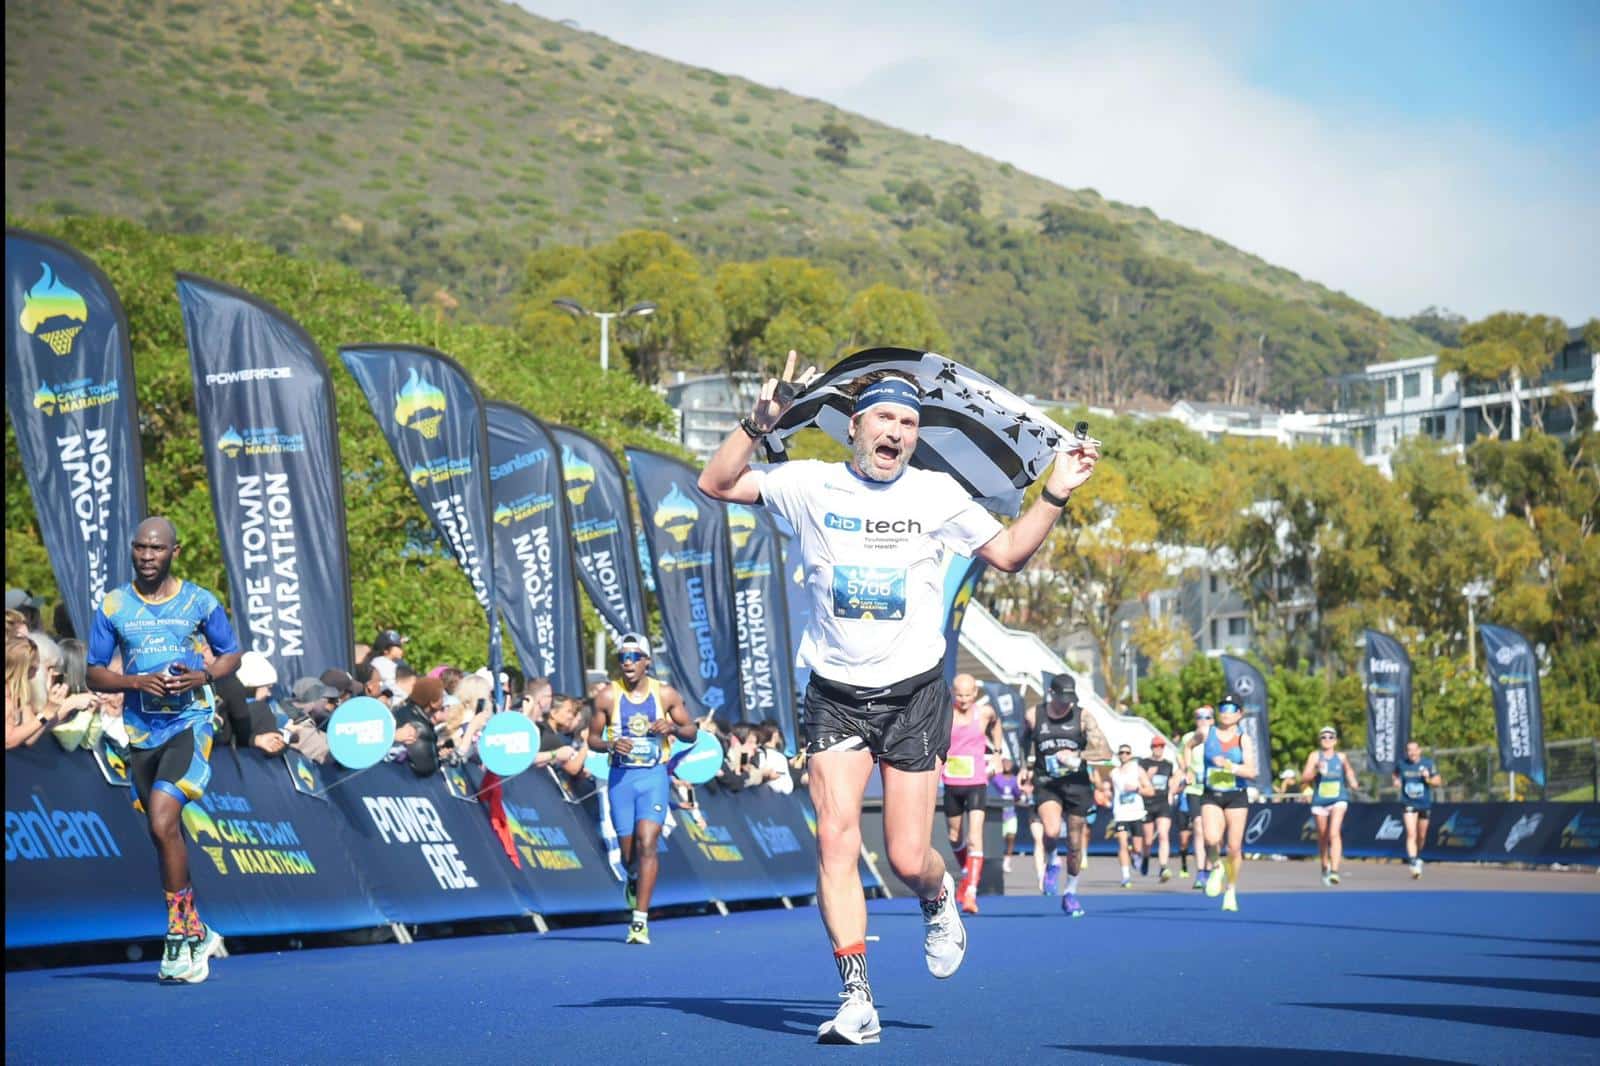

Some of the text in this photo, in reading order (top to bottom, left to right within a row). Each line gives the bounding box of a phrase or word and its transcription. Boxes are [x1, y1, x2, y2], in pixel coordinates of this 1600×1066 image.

[206, 367, 292, 385] POWERADE
[57, 434, 98, 542] TOWN
[830, 515, 922, 535] HD tech
[237, 475, 275, 658] CAPE TOWN
[265, 472, 304, 657] MARATHON
[512, 534, 543, 609] TOWN
[686, 576, 718, 679] sanlam
[745, 589, 774, 708] MARATHON
[217, 819, 301, 845] CAPE TOWN
[362, 796, 452, 843] POWER
[230, 848, 317, 875] MARATHON
